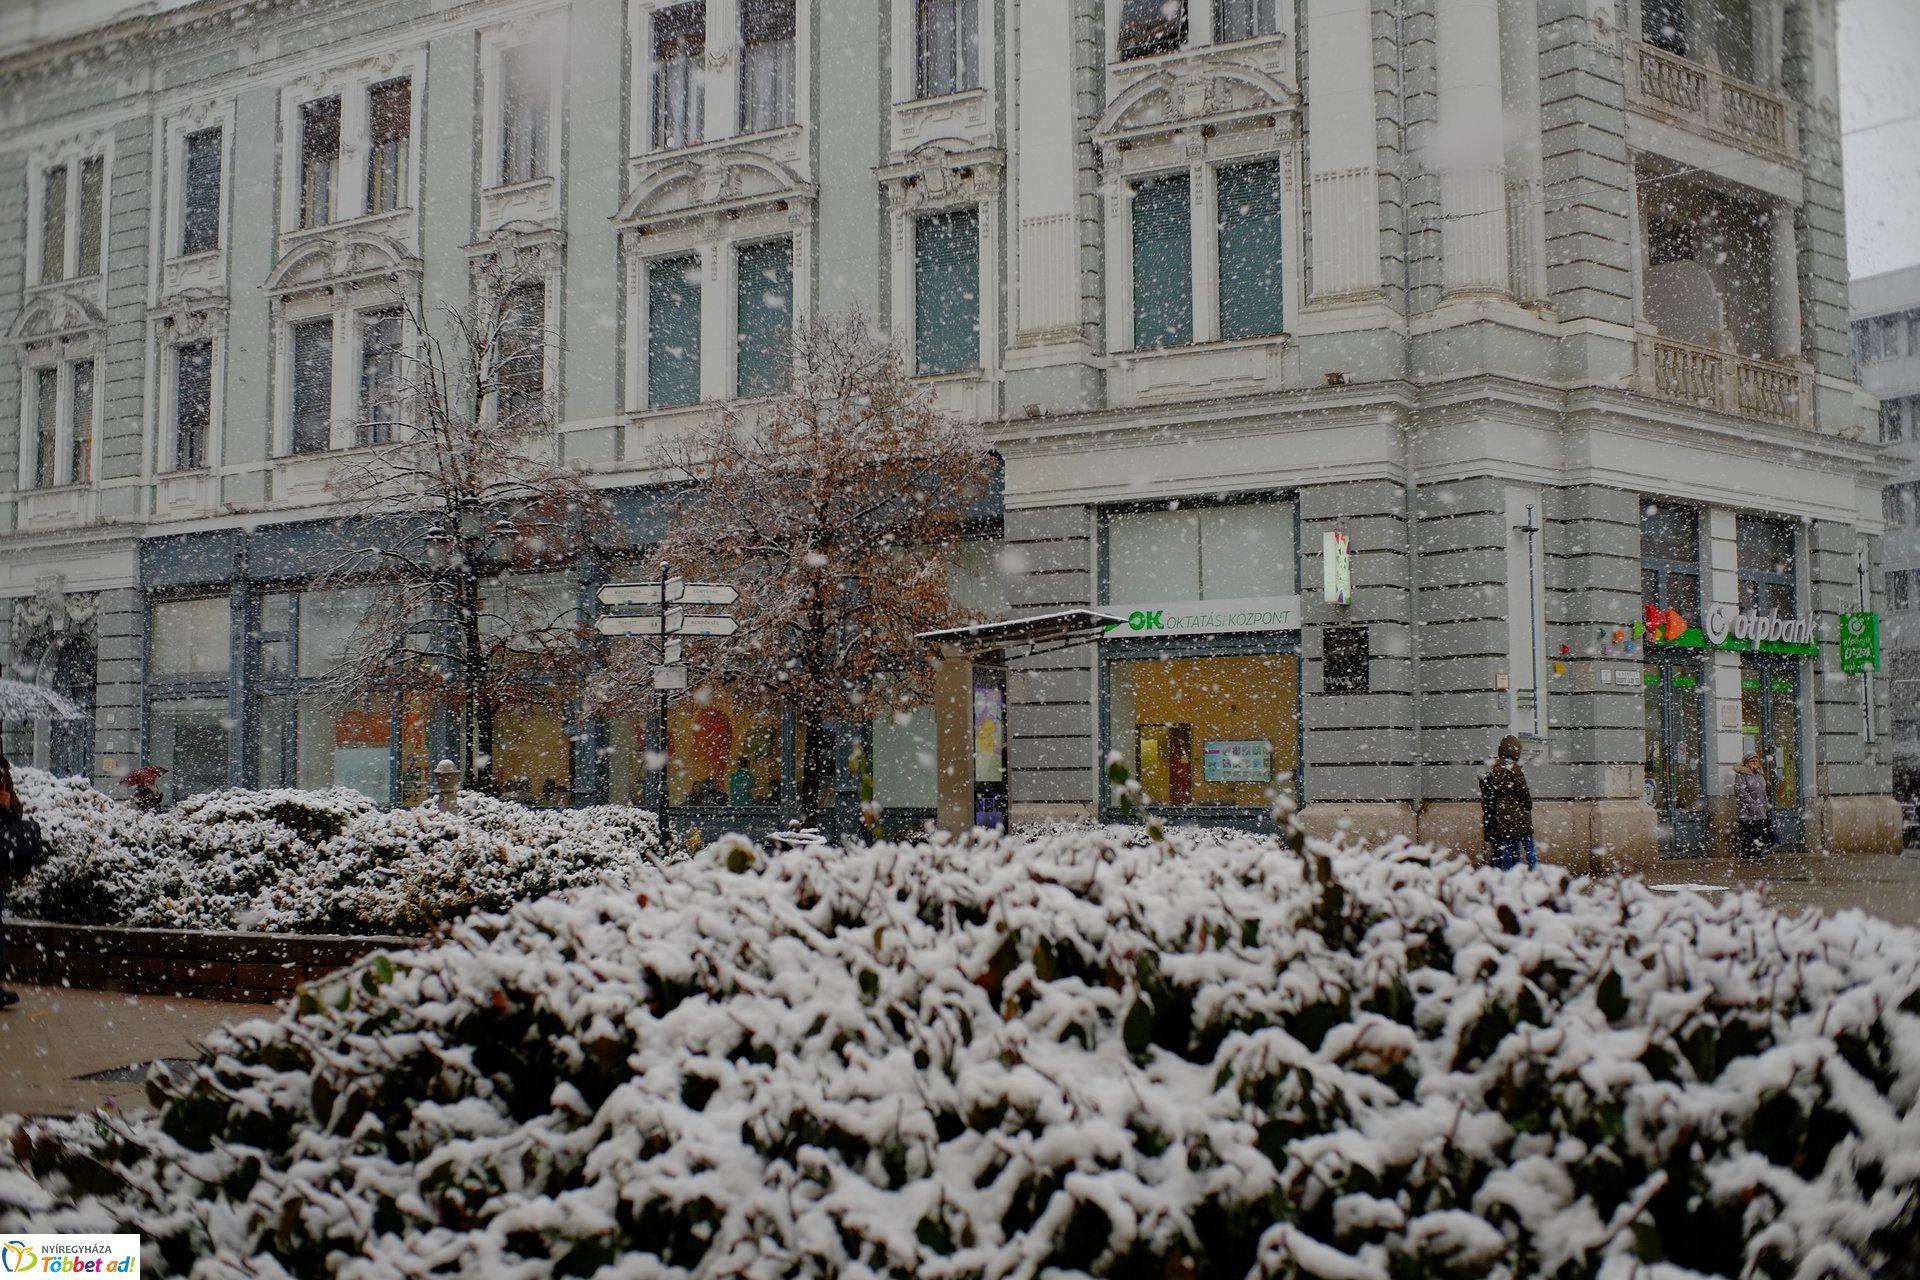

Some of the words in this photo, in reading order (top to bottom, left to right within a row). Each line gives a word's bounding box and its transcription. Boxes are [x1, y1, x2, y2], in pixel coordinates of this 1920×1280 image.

[1128, 610, 1165, 631] OK
[1166, 610, 1225, 630] OKTATÁSI
[1228, 609, 1292, 627] KÖZPONT
[1733, 607, 1818, 650] otpbank
